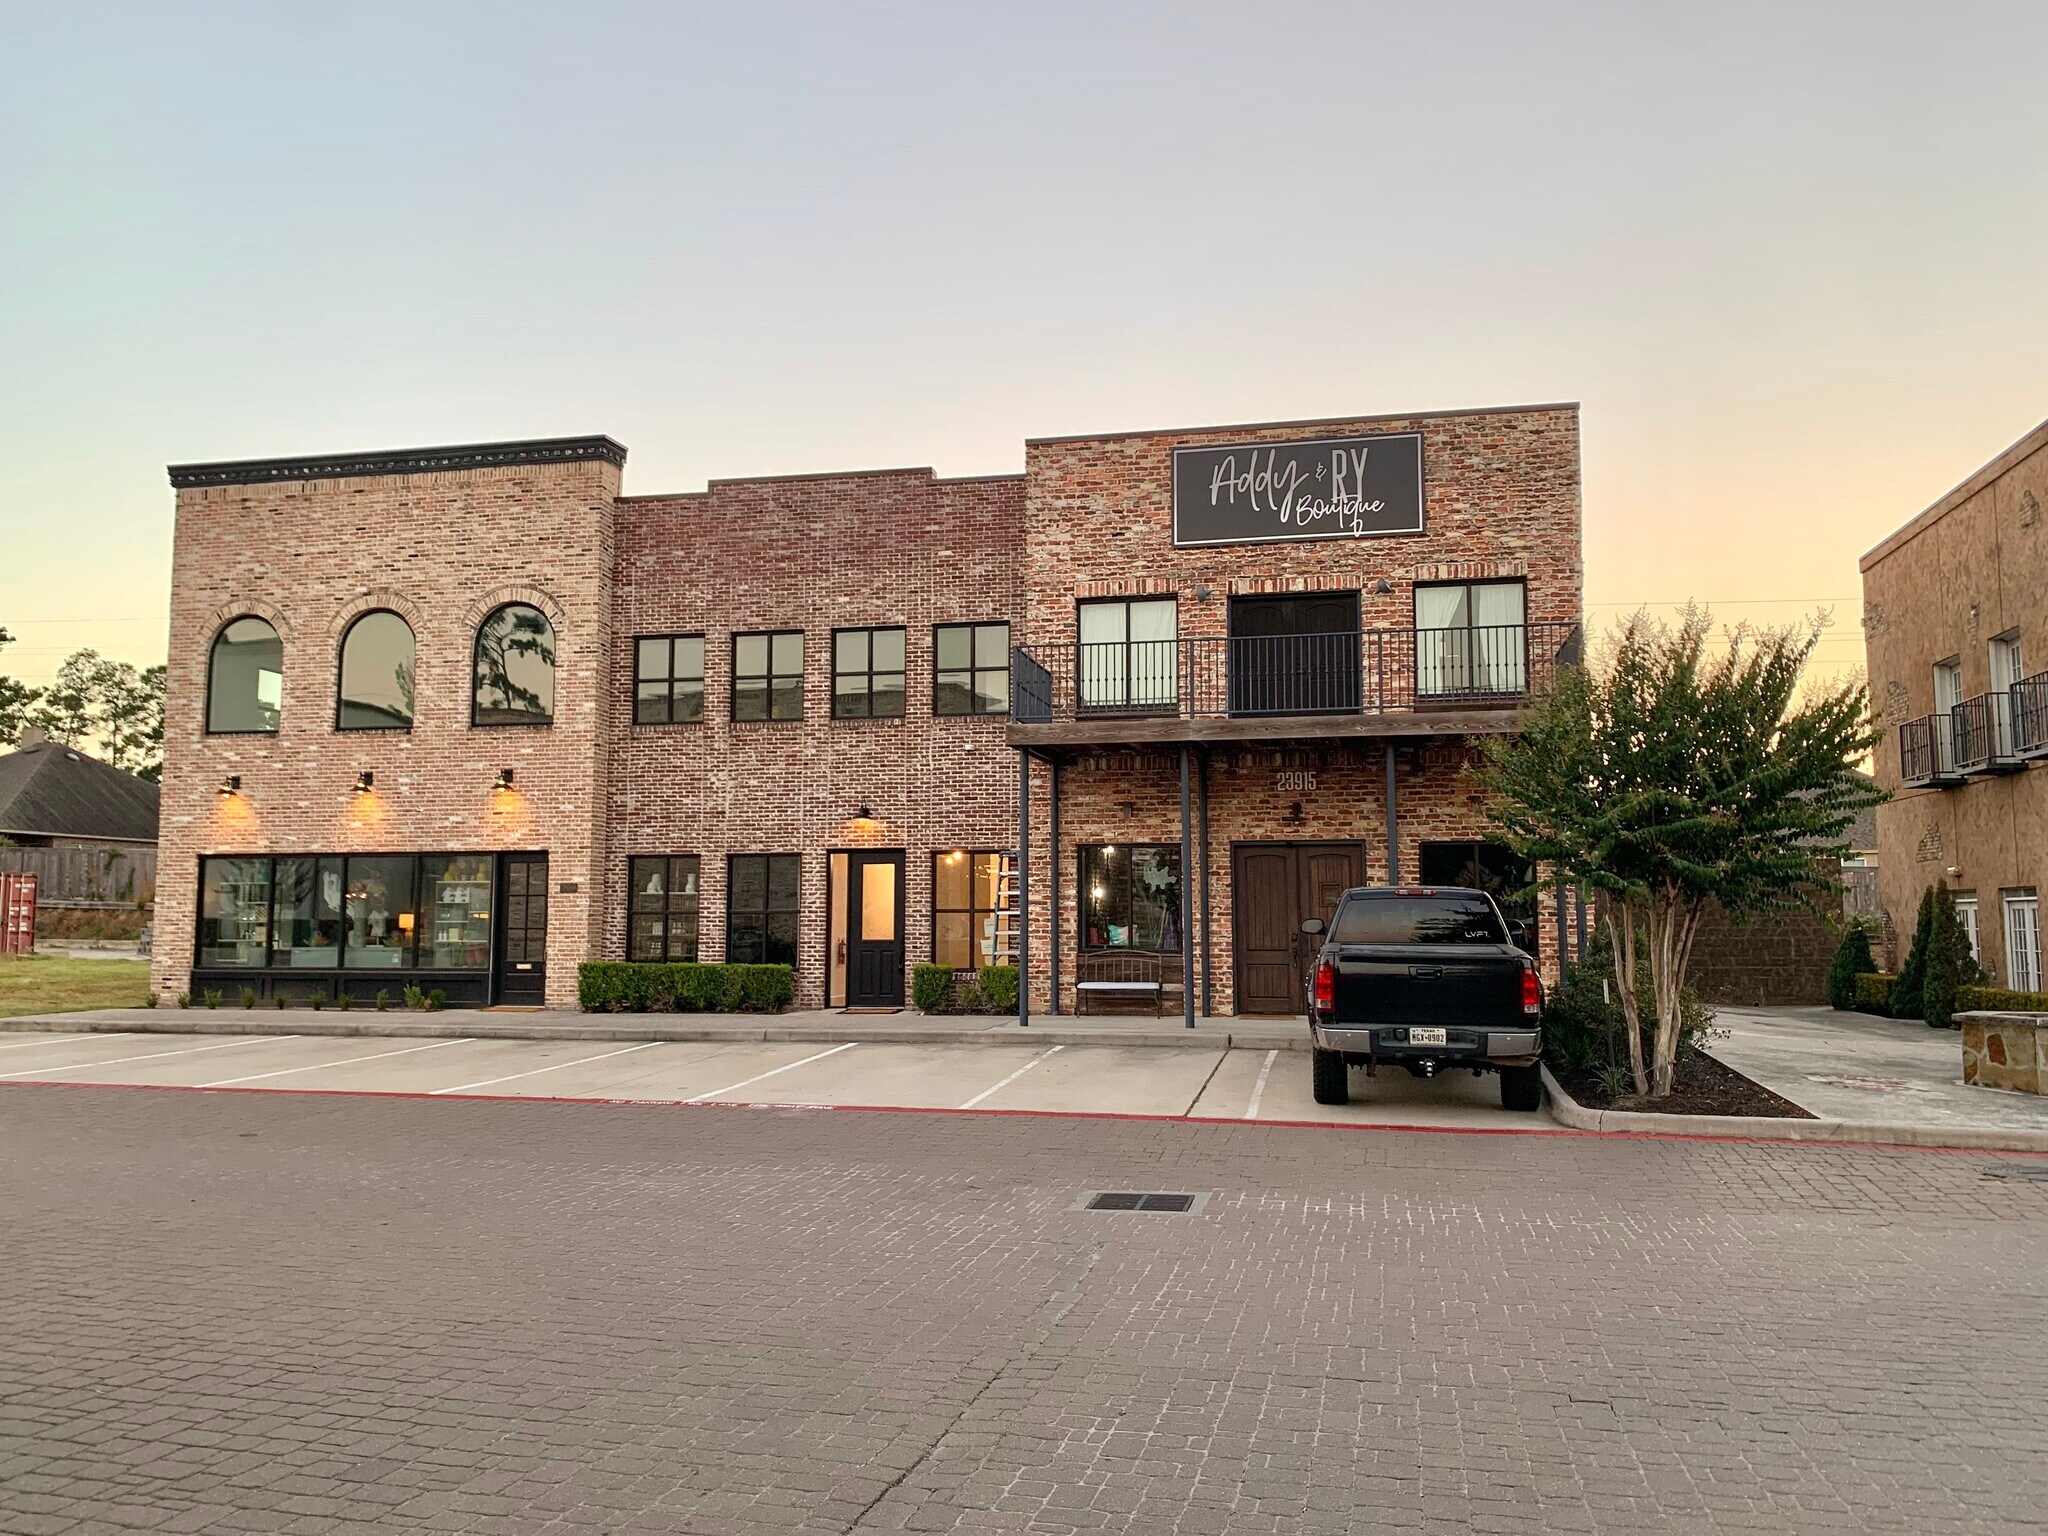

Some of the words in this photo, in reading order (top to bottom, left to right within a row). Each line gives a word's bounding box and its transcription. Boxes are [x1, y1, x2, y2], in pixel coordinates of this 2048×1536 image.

[1209, 449, 1310, 523] Addy
[1315, 462, 1327, 482] &
[1332, 447, 1369, 504] RY
[1296, 492, 1385, 537] Boutique
[1277, 771, 1317, 791] 23915
